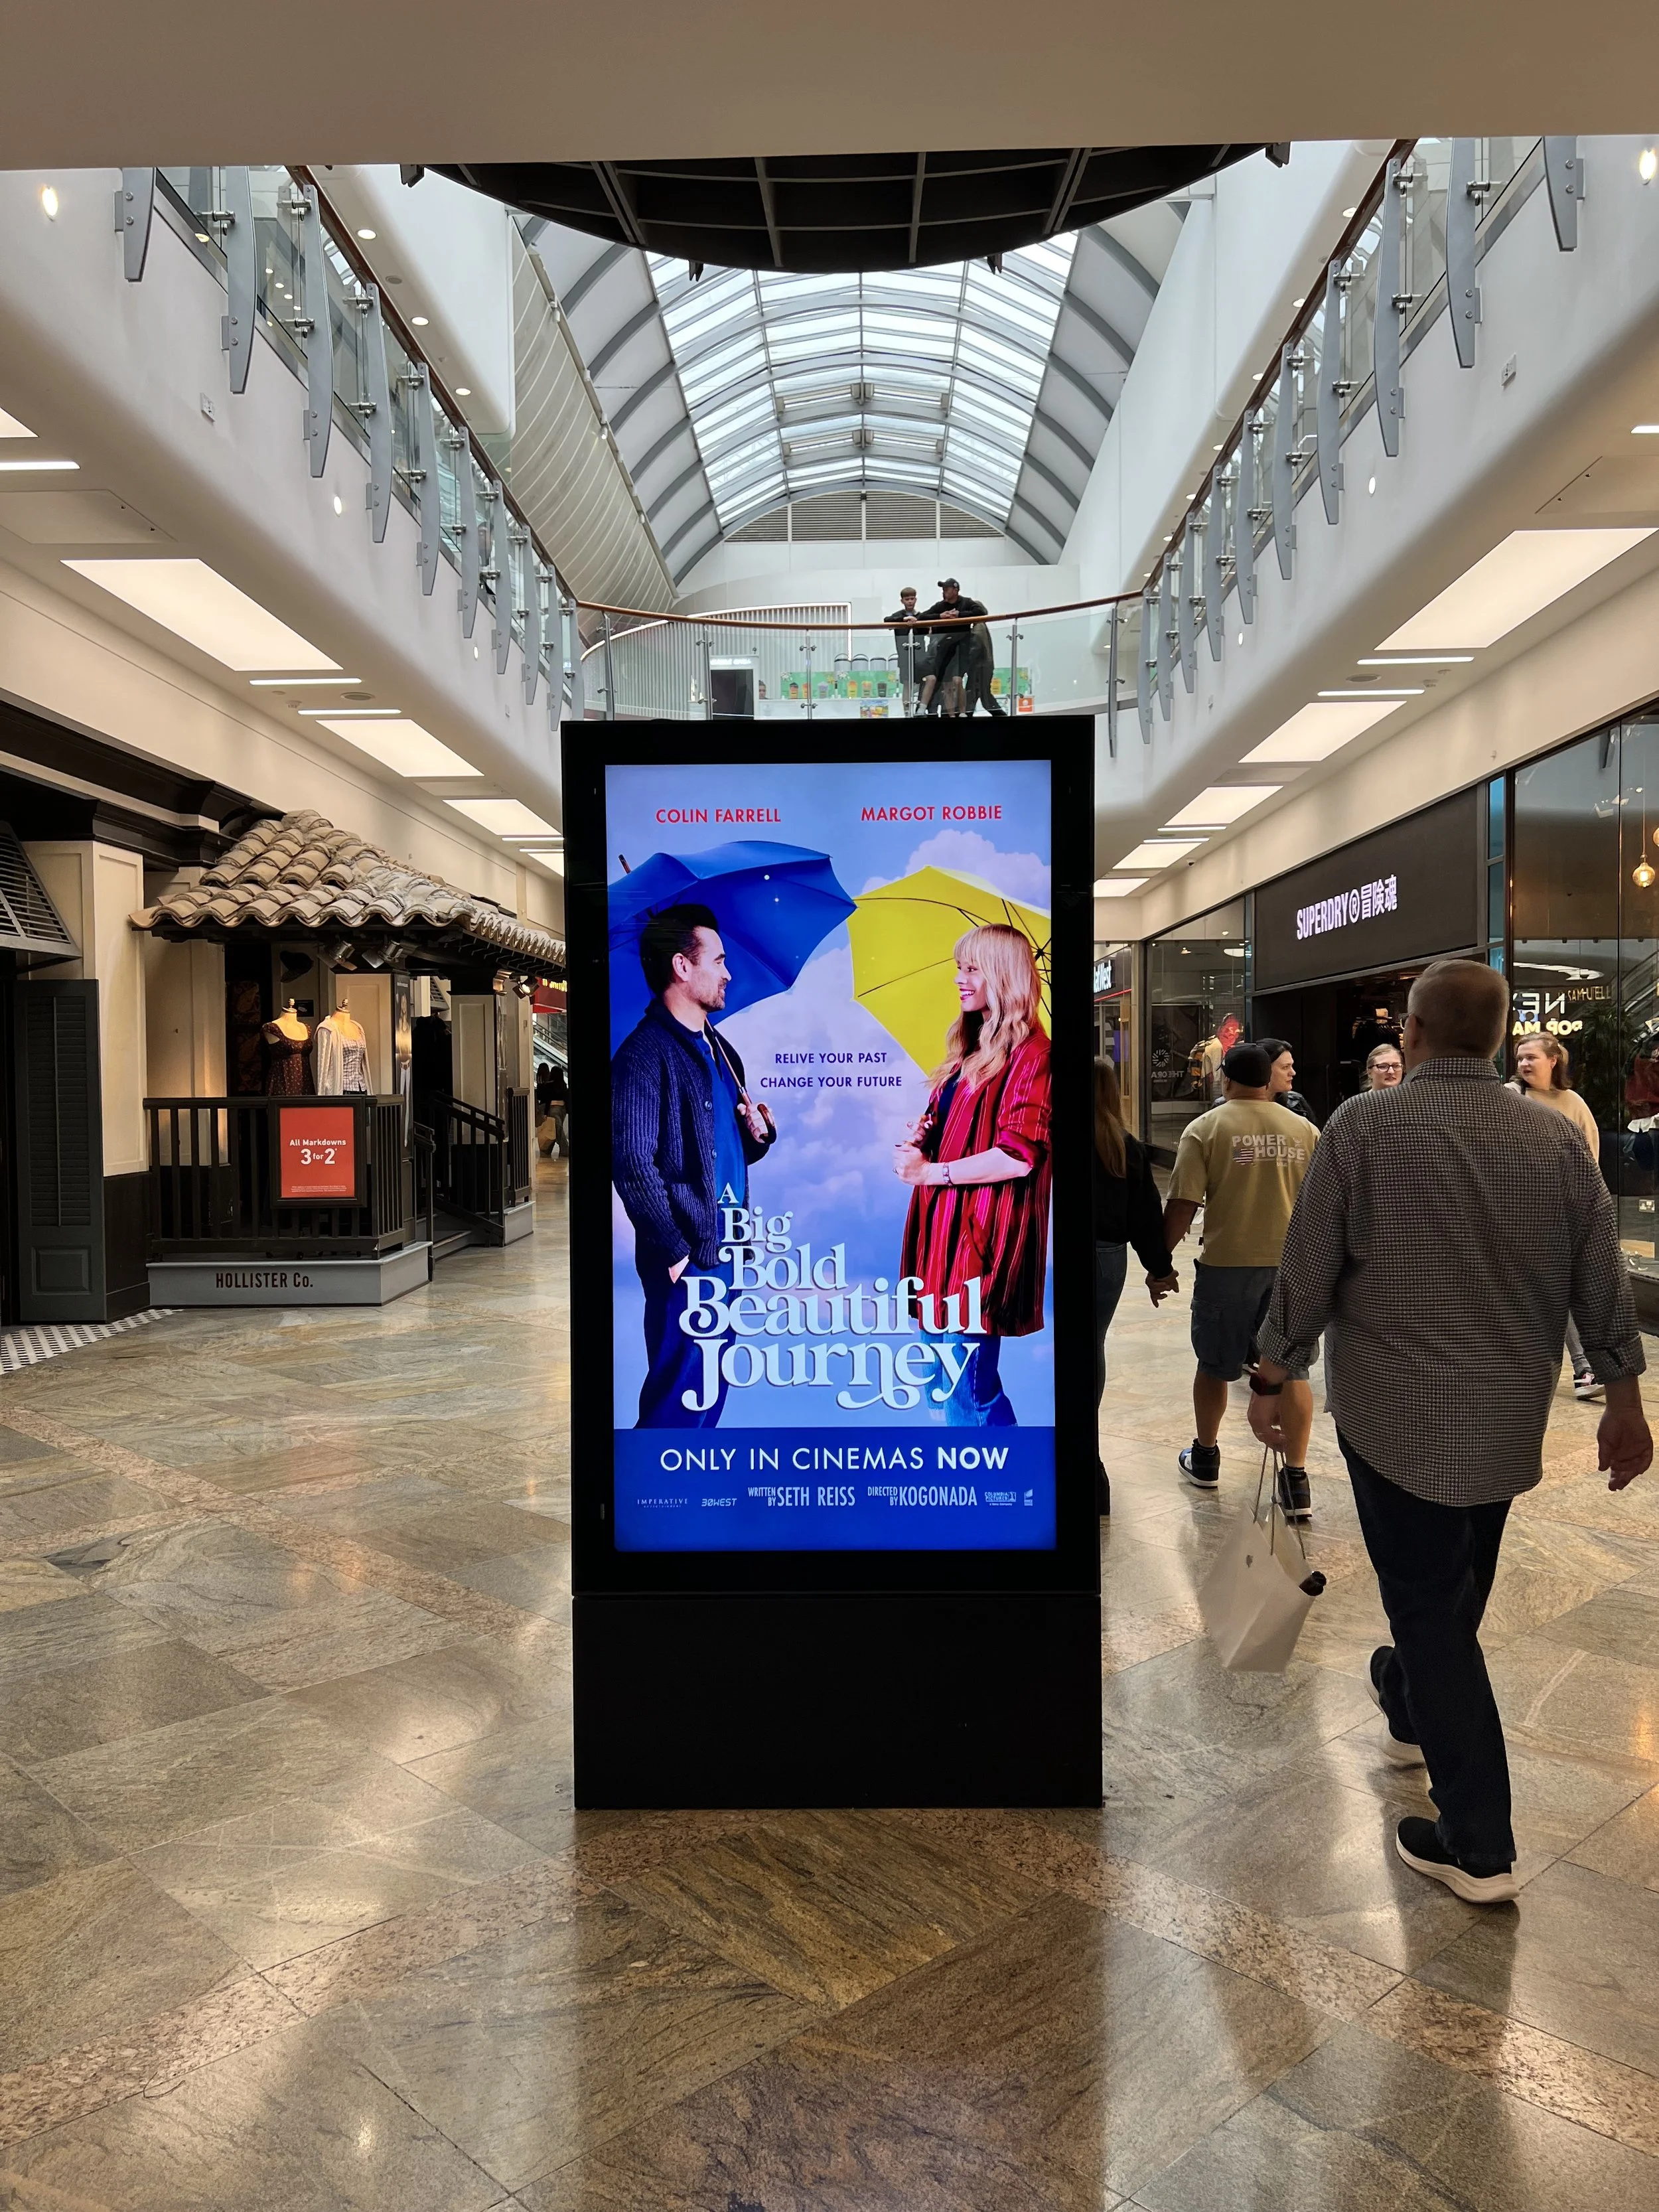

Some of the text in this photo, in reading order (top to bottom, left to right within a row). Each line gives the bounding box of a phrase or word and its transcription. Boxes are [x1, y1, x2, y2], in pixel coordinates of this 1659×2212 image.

[656, 808, 781, 824] COLIN FARRELL
[861, 805, 1002, 822] MARGOT ROBBIE
[775, 1053, 887, 1064] RELIVE YOUR PAST
[760, 1076, 902, 1088] CHANGE YOUR FUTURE
[1232, 1134, 1287, 1147] POWER
[301, 1148, 312, 1165] 3
[1256, 1145, 1305, 1160] HOUSE
[717, 1182, 739, 1204] A
[721, 1207, 794, 1253] Big
[718, 1242, 849, 1290] Bold
[216, 1272, 314, 1288] HOLLISTER Co.
[678, 1276, 987, 1338] Beautiful
[681, 1338, 981, 1411] Journey
[660, 1446, 1009, 1471] ONLY IN CINEMAS NOW
[747, 1486, 776, 1497] WRITTEN
[776, 1486, 856, 1507] SETH REISS
[867, 1486, 899, 1497] DIRECTED
[899, 1485, 978, 1507] KOGONADA
[767, 1498, 776, 1507] BY
[889, 1497, 899, 1507] BY
